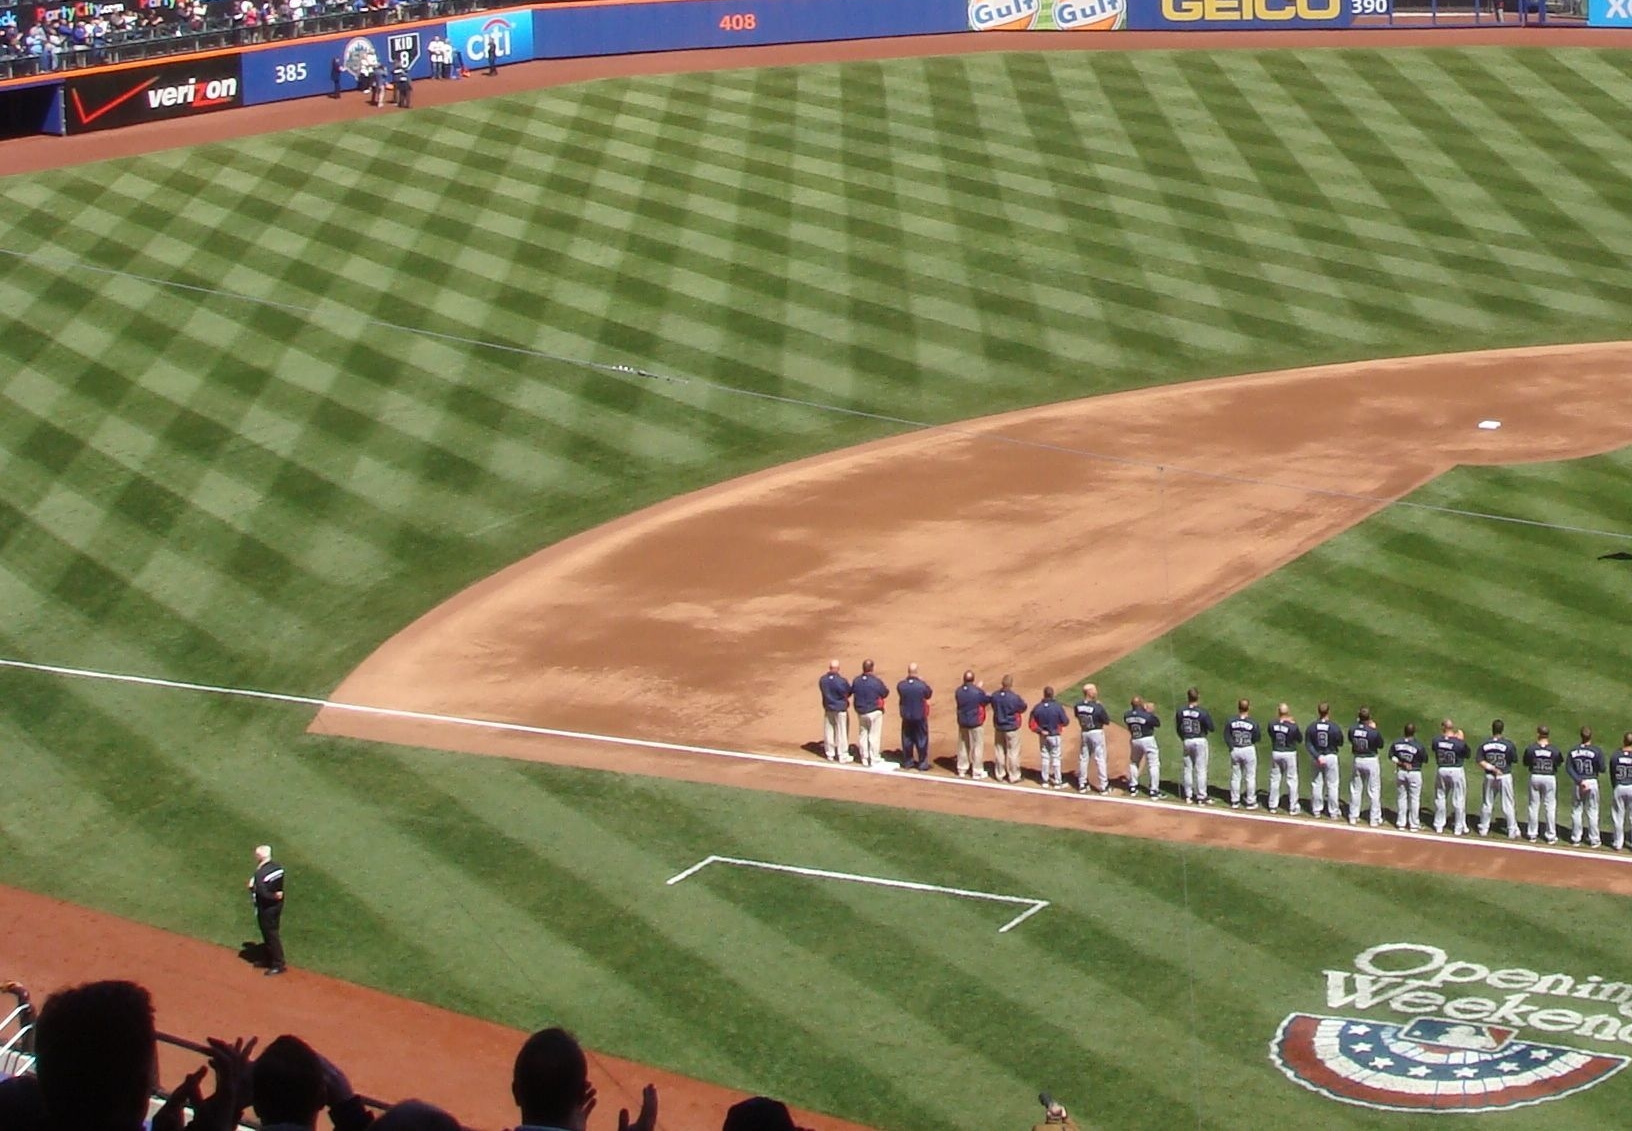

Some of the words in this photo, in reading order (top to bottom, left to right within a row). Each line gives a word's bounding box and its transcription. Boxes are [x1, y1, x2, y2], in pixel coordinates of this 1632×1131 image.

[719, 12, 757, 31] 408
[394, 38, 413, 52] KID
[400, 51, 410, 68] 8
[275, 62, 308, 84] 385
[147, 75, 238, 110] verizon
